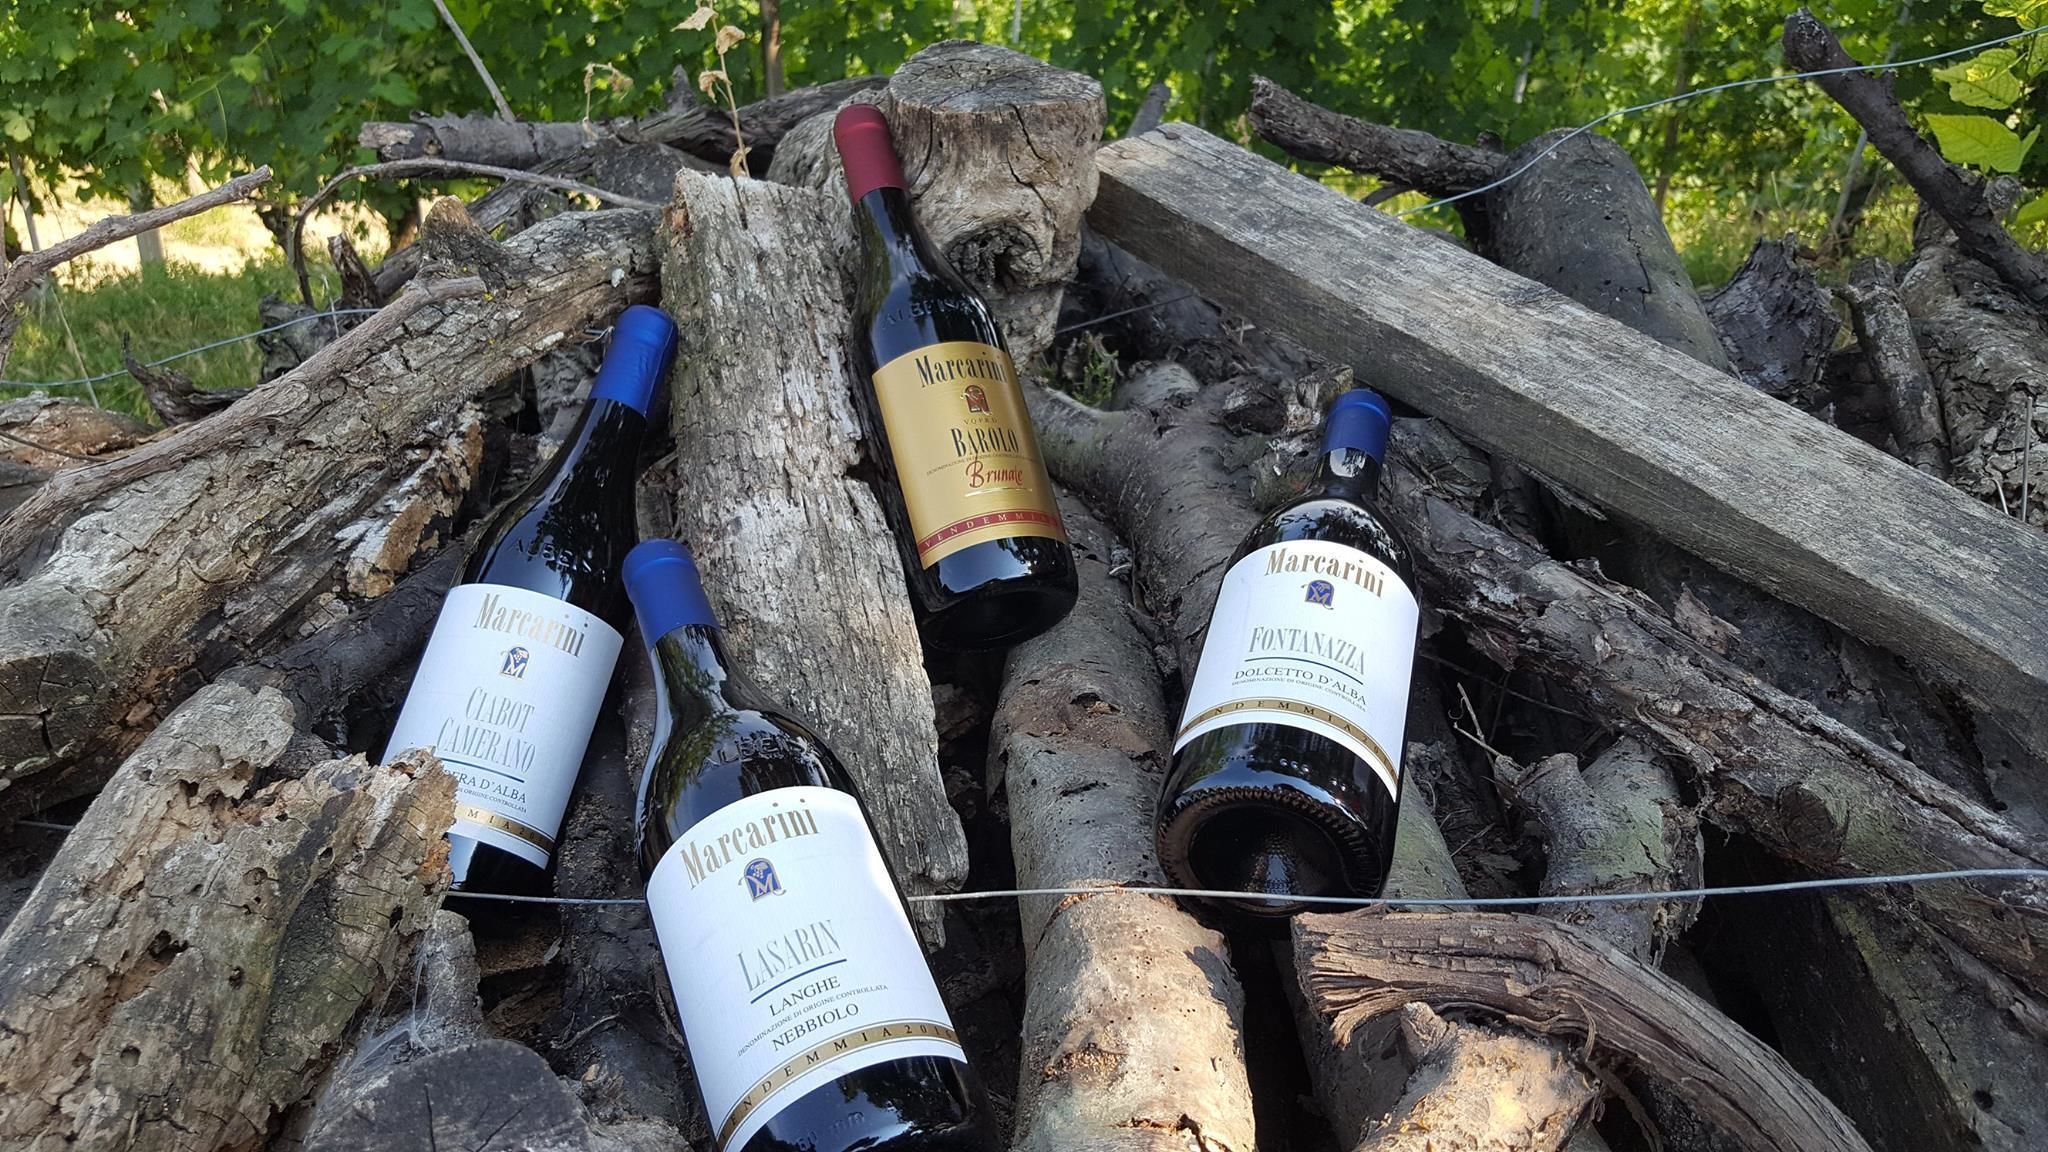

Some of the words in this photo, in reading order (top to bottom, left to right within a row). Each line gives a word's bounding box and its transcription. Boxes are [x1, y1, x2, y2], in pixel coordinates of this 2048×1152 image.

[915, 351, 1009, 388] Marcarini
[951, 427, 1019, 458] BAROLO
[966, 454, 1024, 488] Brunate
[1264, 548, 1385, 598] Marcarini
[473, 593, 588, 657] Marcarini
[1249, 626, 1365, 675] FONTANAZZA
[1235, 667, 1314, 680] DOLCETTO
[1318, 674, 1367, 705] D'ALBA
[437, 717, 536, 773] CAMERANO
[464, 788, 489, 800] ORIGINE
[480, 778, 527, 804] D'ALBA
[680, 799, 819, 889] Marcarini
[737, 919, 841, 992] LASARIN
[769, 976, 841, 1016] LANGHE
[737, 1016, 793, 1057] DENOMINAZIONE
[793, 1010, 802, 1018] DI
[803, 996, 835, 1014] ORIGINE
[835, 984, 888, 1000] CONTROLLATA
[772, 1003, 859, 1051] NEBBIOLO
